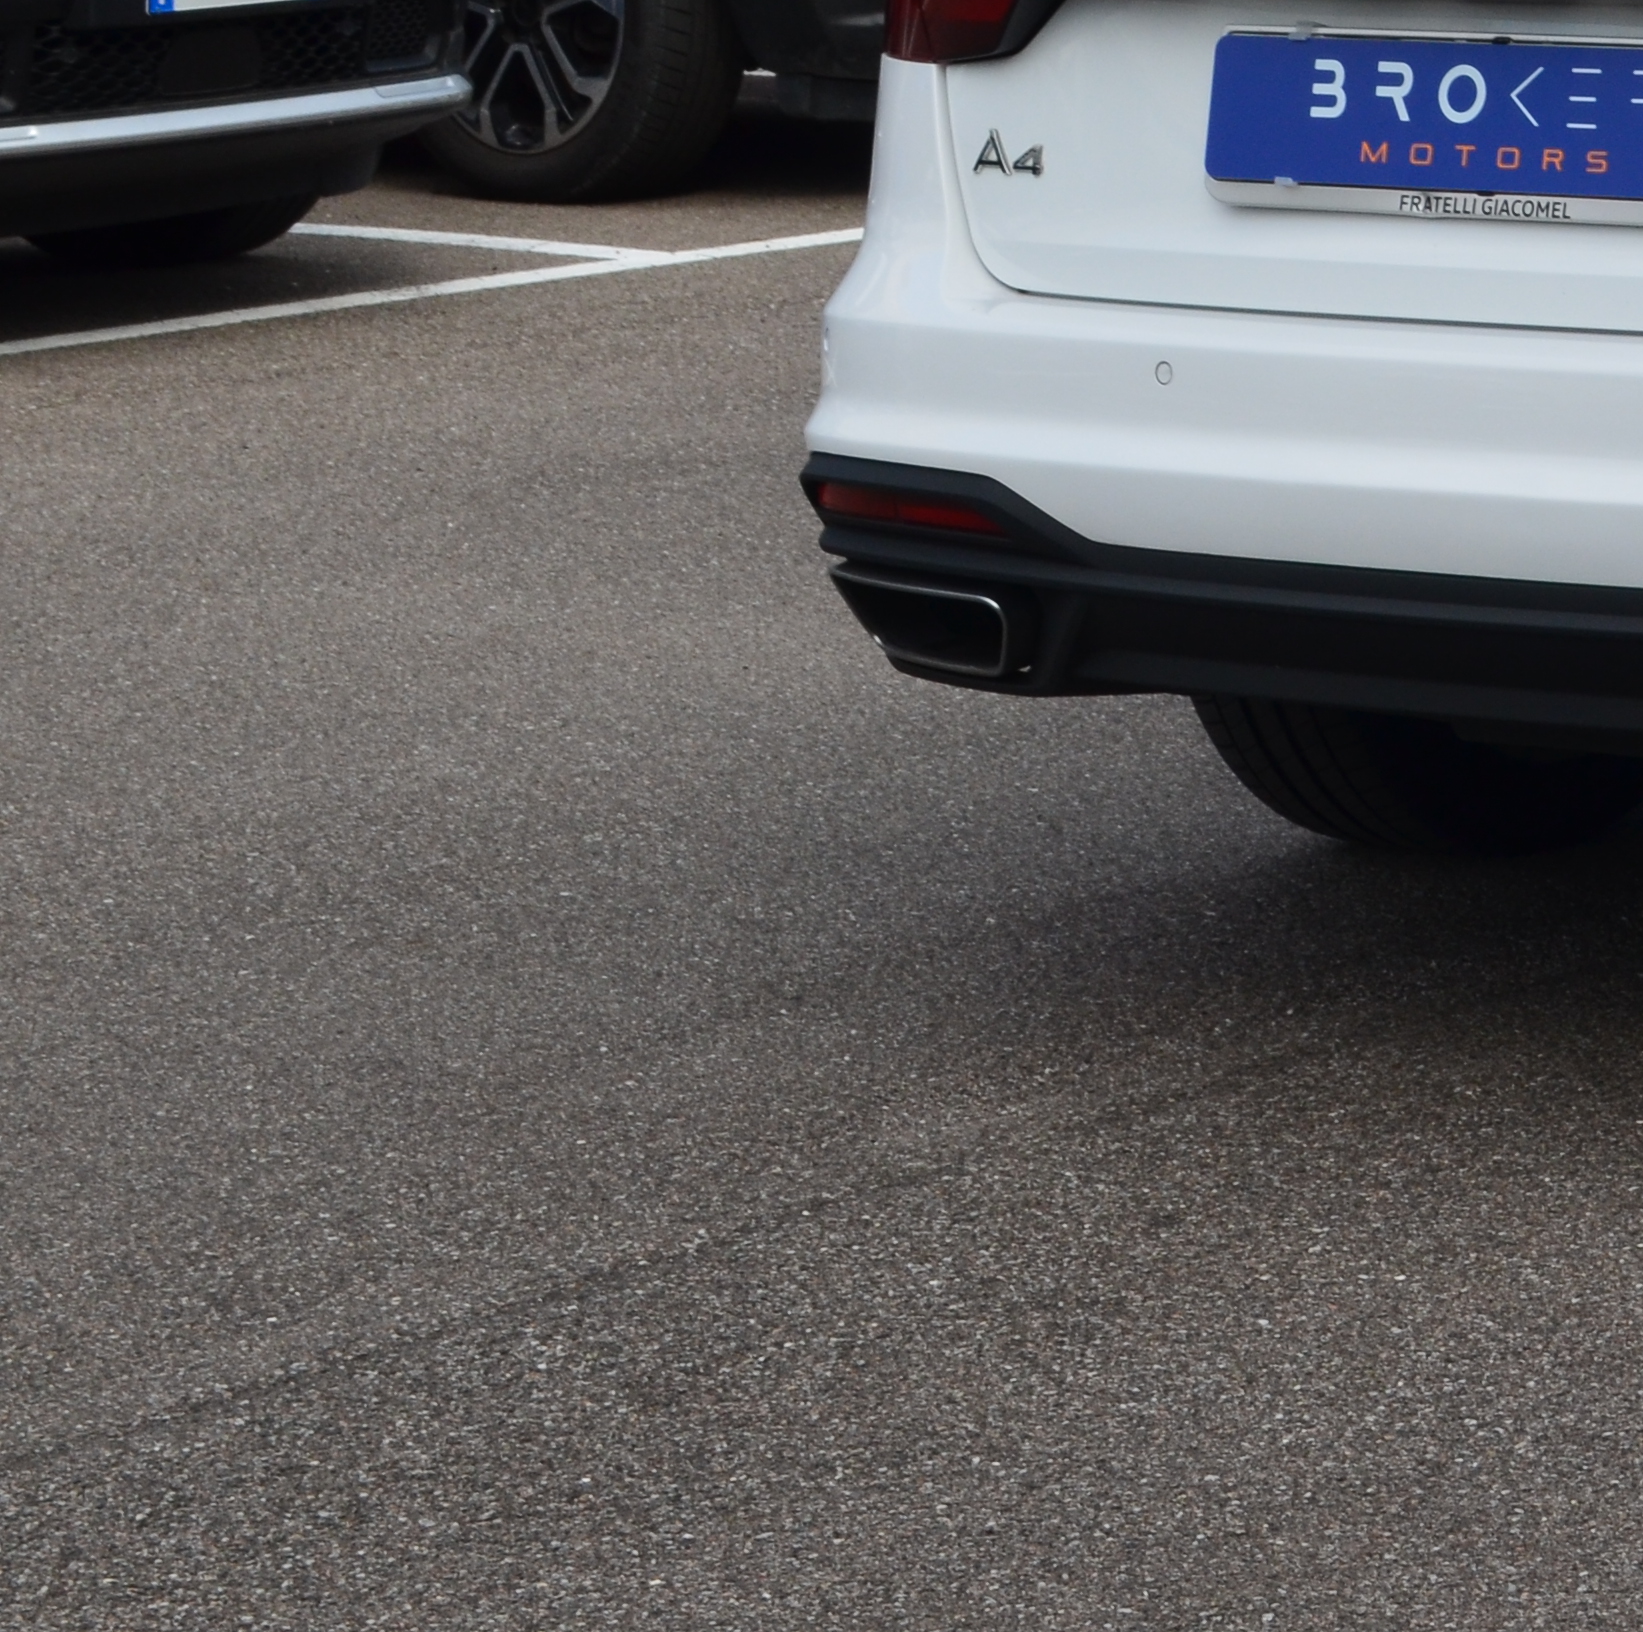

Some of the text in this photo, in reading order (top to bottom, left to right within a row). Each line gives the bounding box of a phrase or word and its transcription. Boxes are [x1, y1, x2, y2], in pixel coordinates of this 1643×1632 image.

[973, 128, 1044, 178] A4
[1360, 141, 1609, 174] MOTORS
[1399, 194, 1571, 220] FRATELLI GIACOMEL
